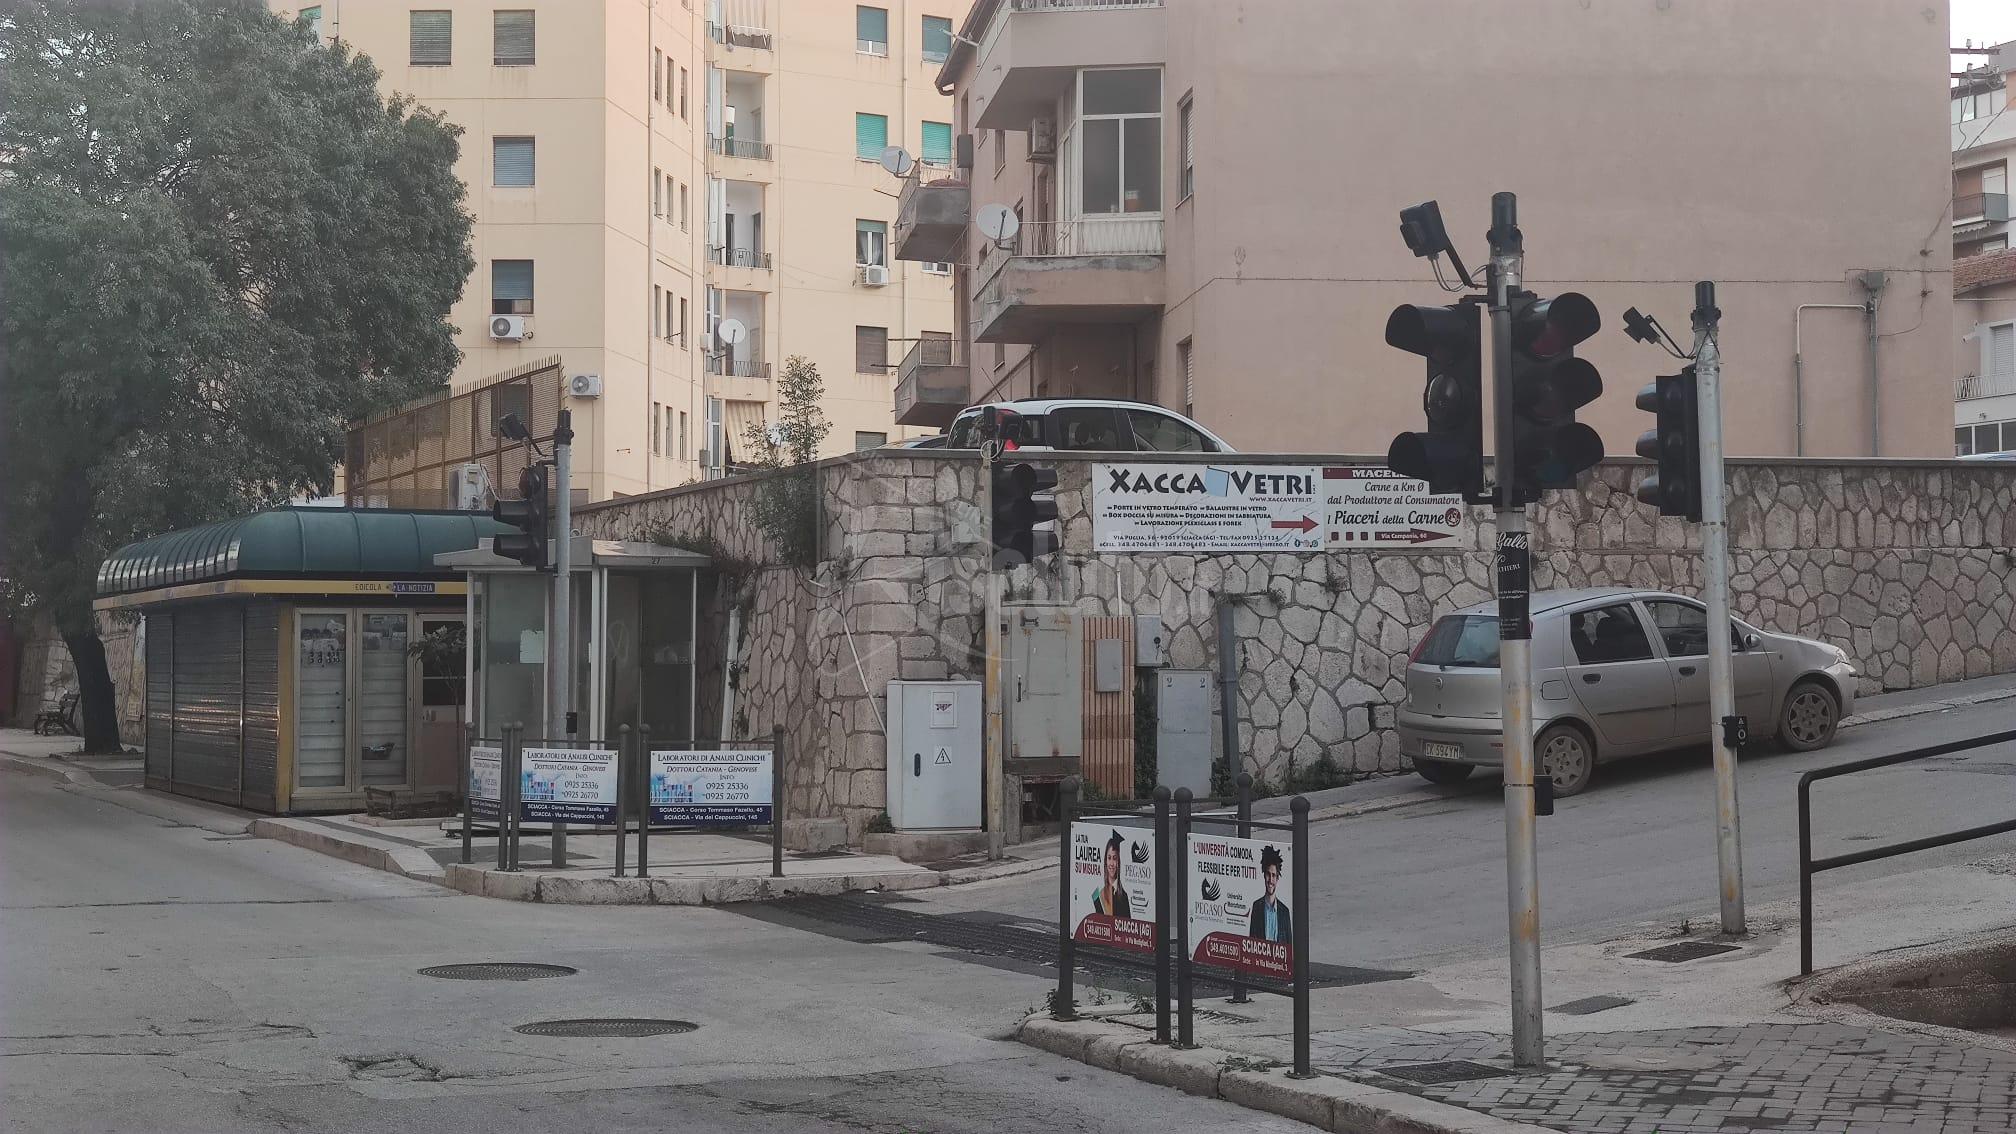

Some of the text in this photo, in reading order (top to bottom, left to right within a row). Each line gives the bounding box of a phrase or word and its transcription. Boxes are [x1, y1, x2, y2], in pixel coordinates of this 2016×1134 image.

[1109, 468, 1207, 495] XACCA
[1229, 470, 1313, 495] VETRI
[1364, 482, 1391, 492] Carne
[1401, 482, 1416, 492] Km
[1327, 494, 1460, 506] dal Produttore al Consumatore
[1334, 510, 1380, 525] Piaceri
[1382, 515, 1404, 525] della
[1407, 510, 1445, 525] Carne
[355, 583, 382, 591] EDICOLA
[408, 583, 433, 592] NOTIZIA
[527, 751, 613, 761] LABORATORI DI ANALISI CLINICHE
[657, 754, 766, 762] LABORATORI DI ANALISI CLINICHE
[666, 765, 695, 773] DOTTORI
[695, 765, 723, 773] CATANIA
[727, 765, 758, 773] GENOVESE
[564, 780, 599, 790] 0925 25336
[705, 782, 749, 791] 0925 25336
[563, 790, 599, 800] 0925 26770
[705, 792, 750, 801] 0925 26770
[1075, 833, 1081, 843] LA
[1075, 846, 1102, 863] LAUREA
[1193, 841, 1229, 858] L'UNIVERSITÀ
[1074, 863, 1102, 877] SU MISURA
[1125, 864, 1152, 880] PEGASO
[1197, 861, 1226, 876] FLESSIBILE
[1230, 865, 1241, 878] PER
[1241, 866, 1257, 880] TUTTI
[1194, 901, 1224, 918] PEGASO
[1114, 919, 1152, 940] SCIACCA (AG)
[1242, 939, 1287, 963] SCIACCA (AG)
